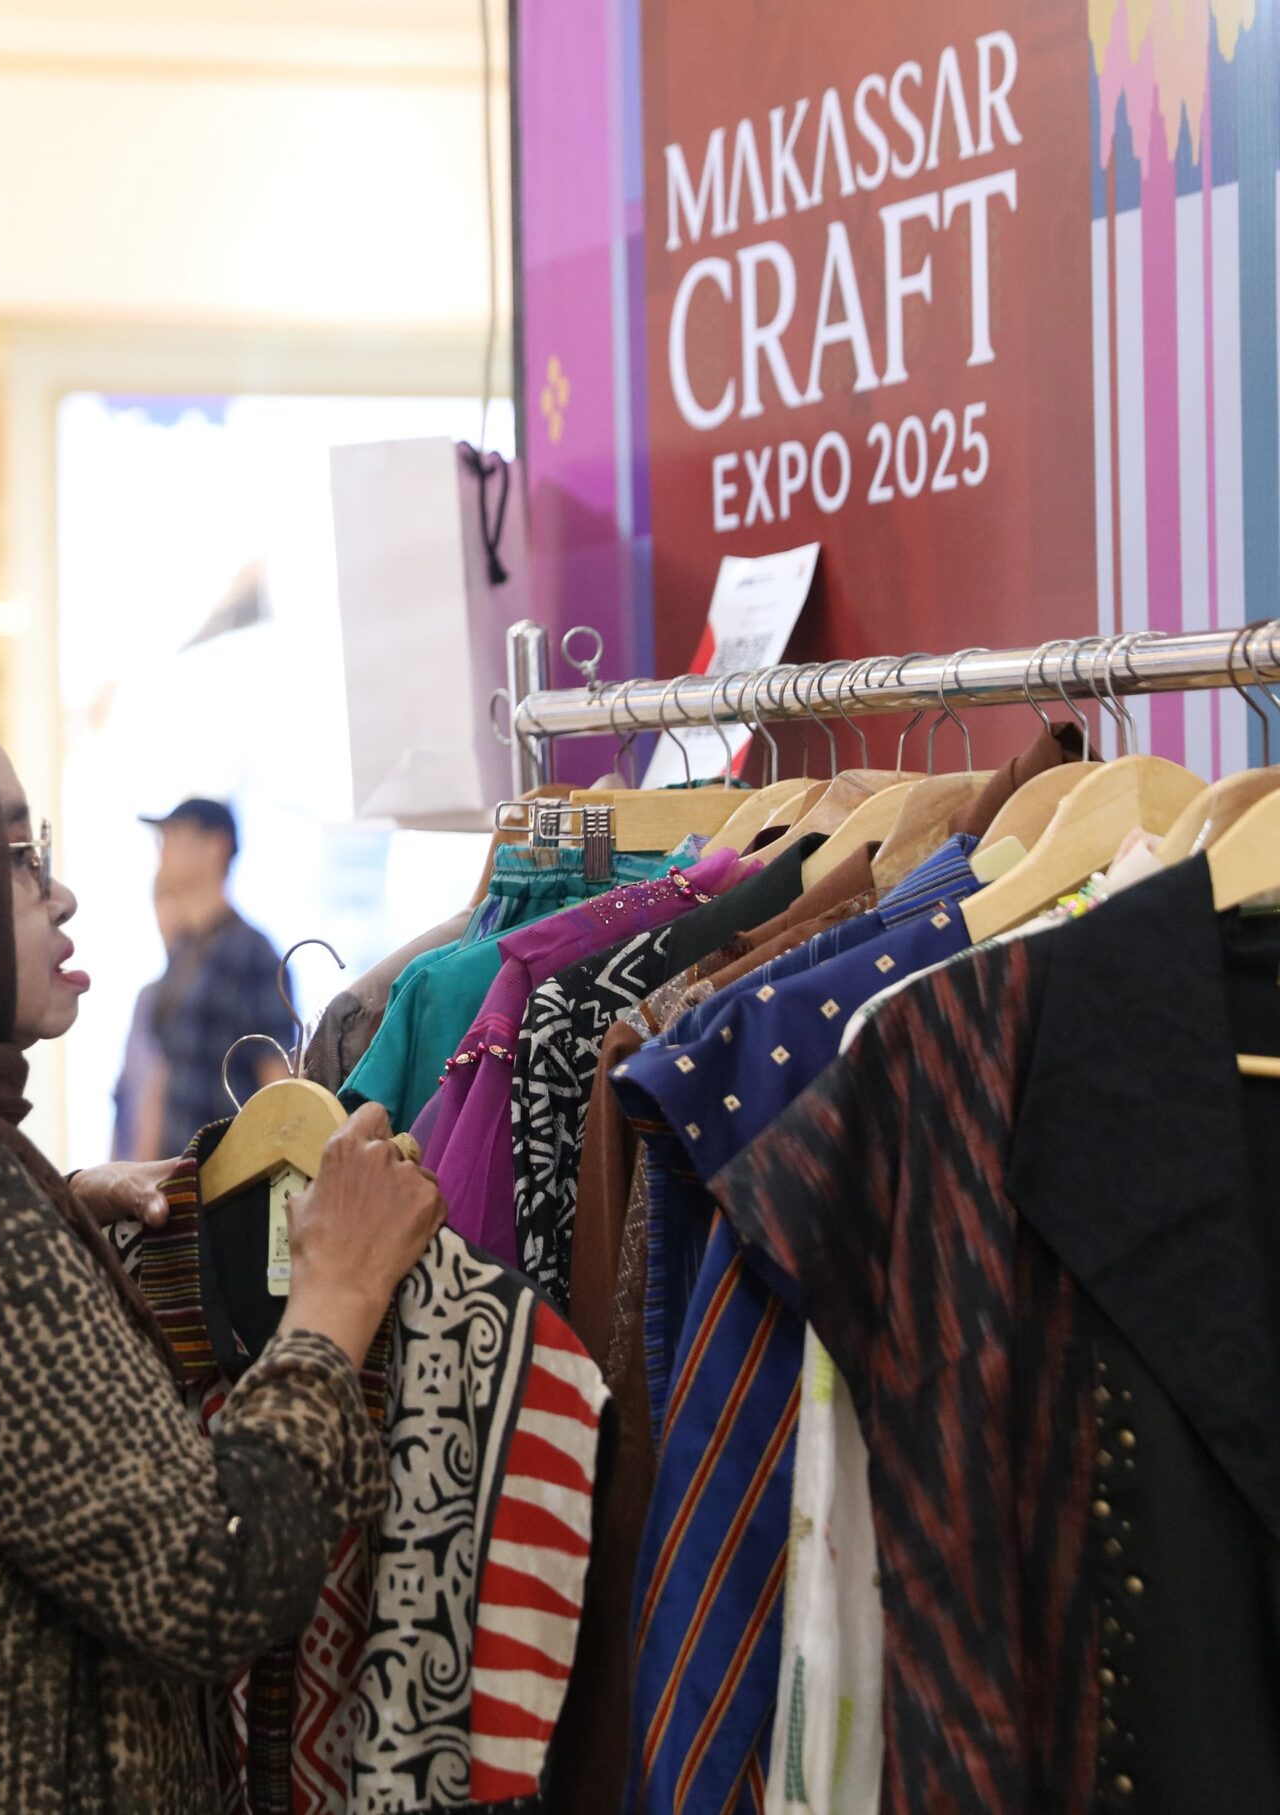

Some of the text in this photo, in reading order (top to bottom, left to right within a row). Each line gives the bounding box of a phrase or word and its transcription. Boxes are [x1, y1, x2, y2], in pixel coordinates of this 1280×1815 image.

[665, 30, 1022, 252] MAKASSAR
[668, 169, 1018, 431] CRAFT
[713, 401, 990, 533] EXPO 2025
